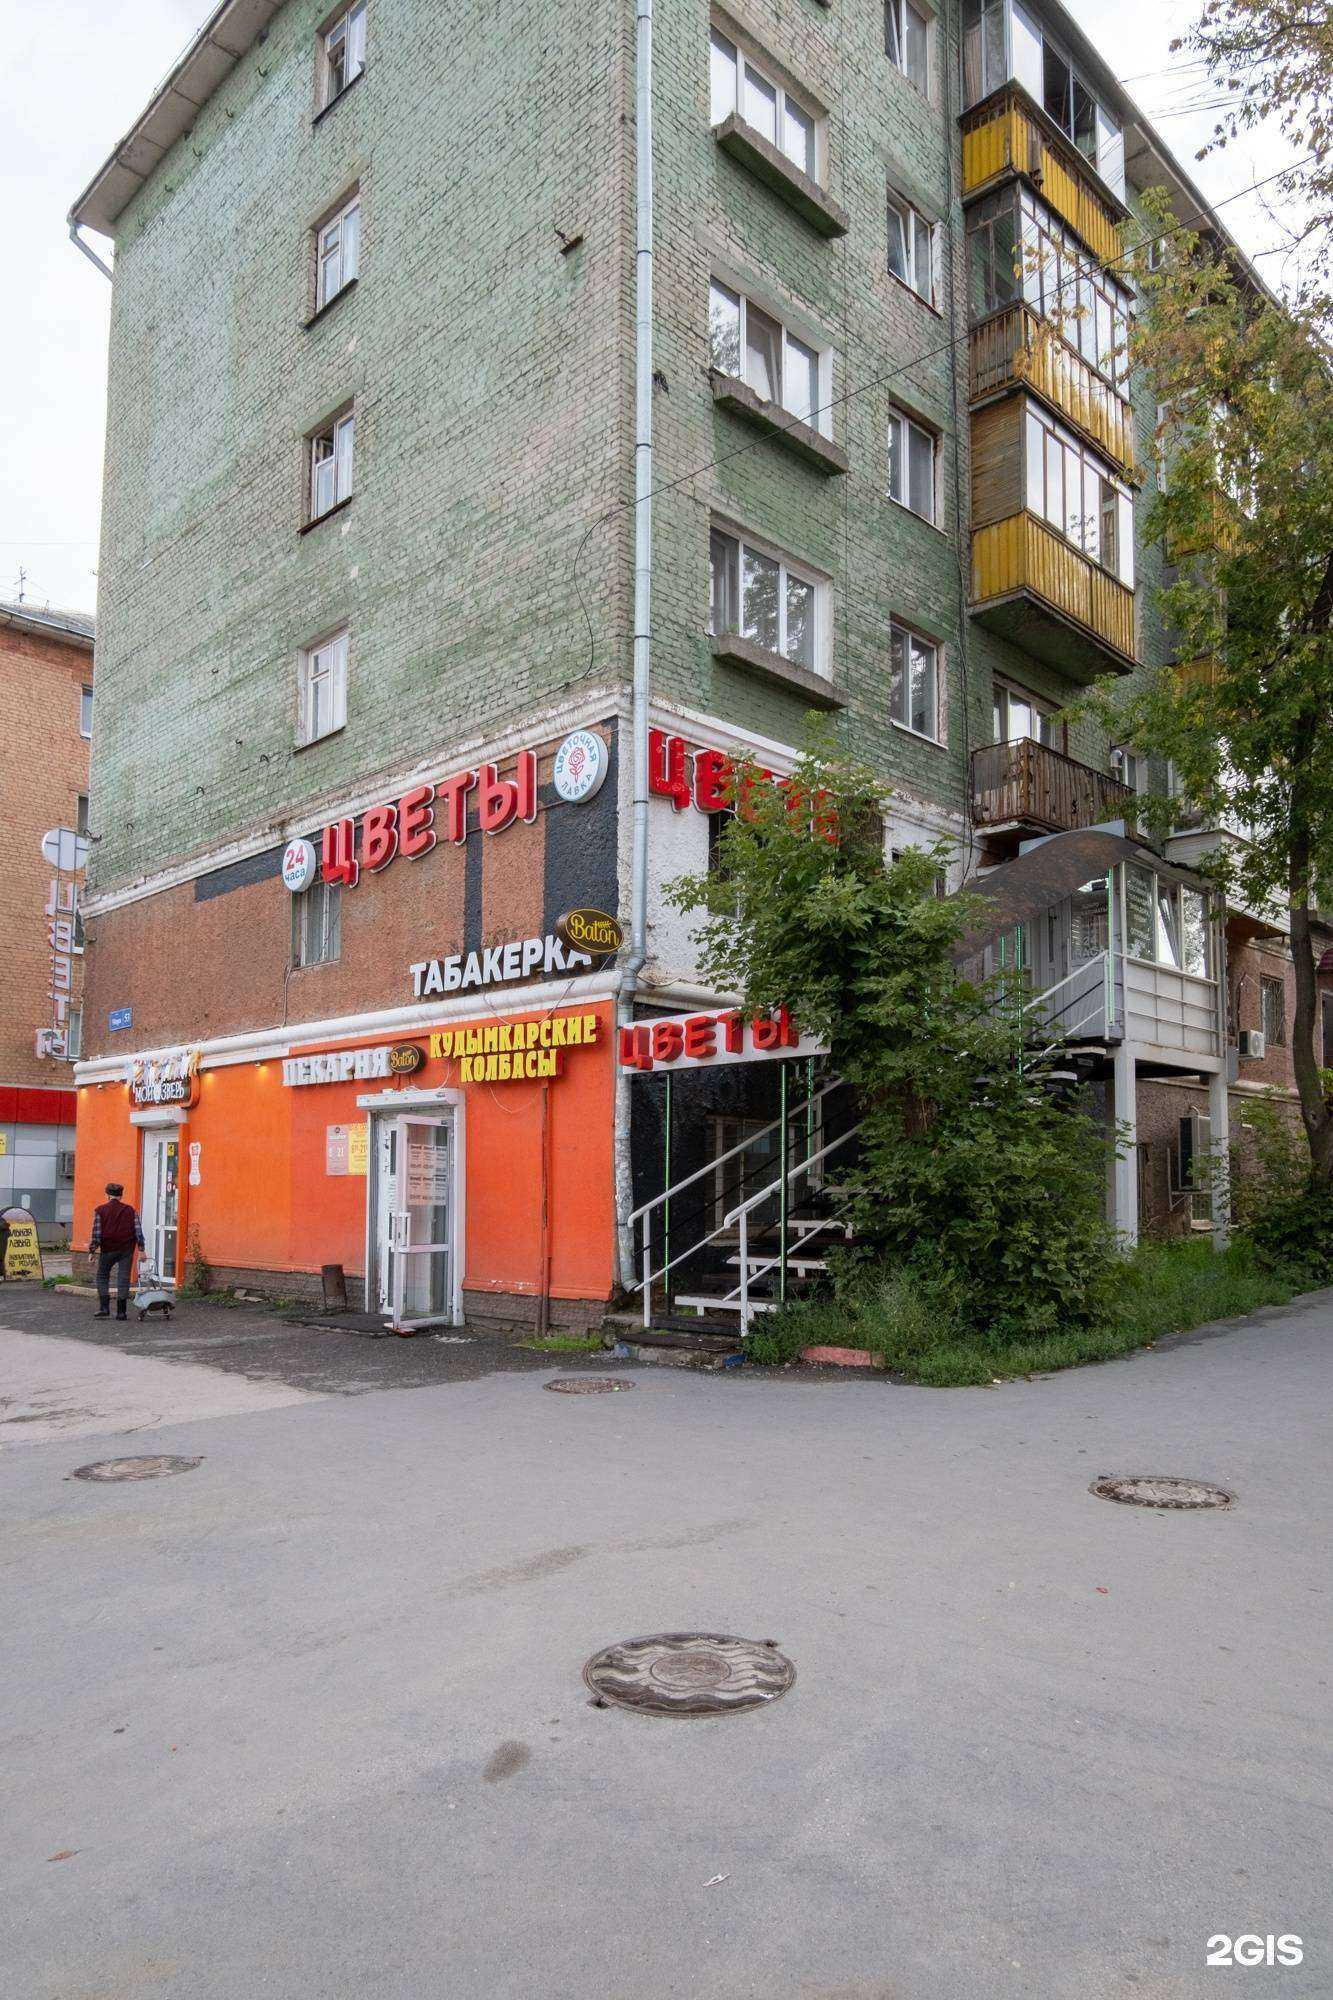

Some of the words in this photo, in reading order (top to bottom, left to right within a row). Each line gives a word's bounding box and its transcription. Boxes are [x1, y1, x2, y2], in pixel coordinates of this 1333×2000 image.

[556, 734, 597, 774] ЦВЕТОЧНАЯ
[561, 774, 592, 796] ЛАВКА
[322, 750, 538, 889] ЦВЕТЫ
[285, 868, 305, 882] часа
[286, 844, 304, 870] 24
[570, 914, 619, 946] Baton
[409, 934, 592, 997] ТАБАКЕРКА
[430, 1015, 597, 1059] КУДЫМКАРСКИЕ
[619, 1003, 799, 1070] ЦВЕТЫ
[282, 1047, 393, 1086] ПЕКАРНЯ
[460, 1049, 557, 1083] КОЛБАСЫ
[160, 1082, 185, 1101] ЗВЕРЬ
